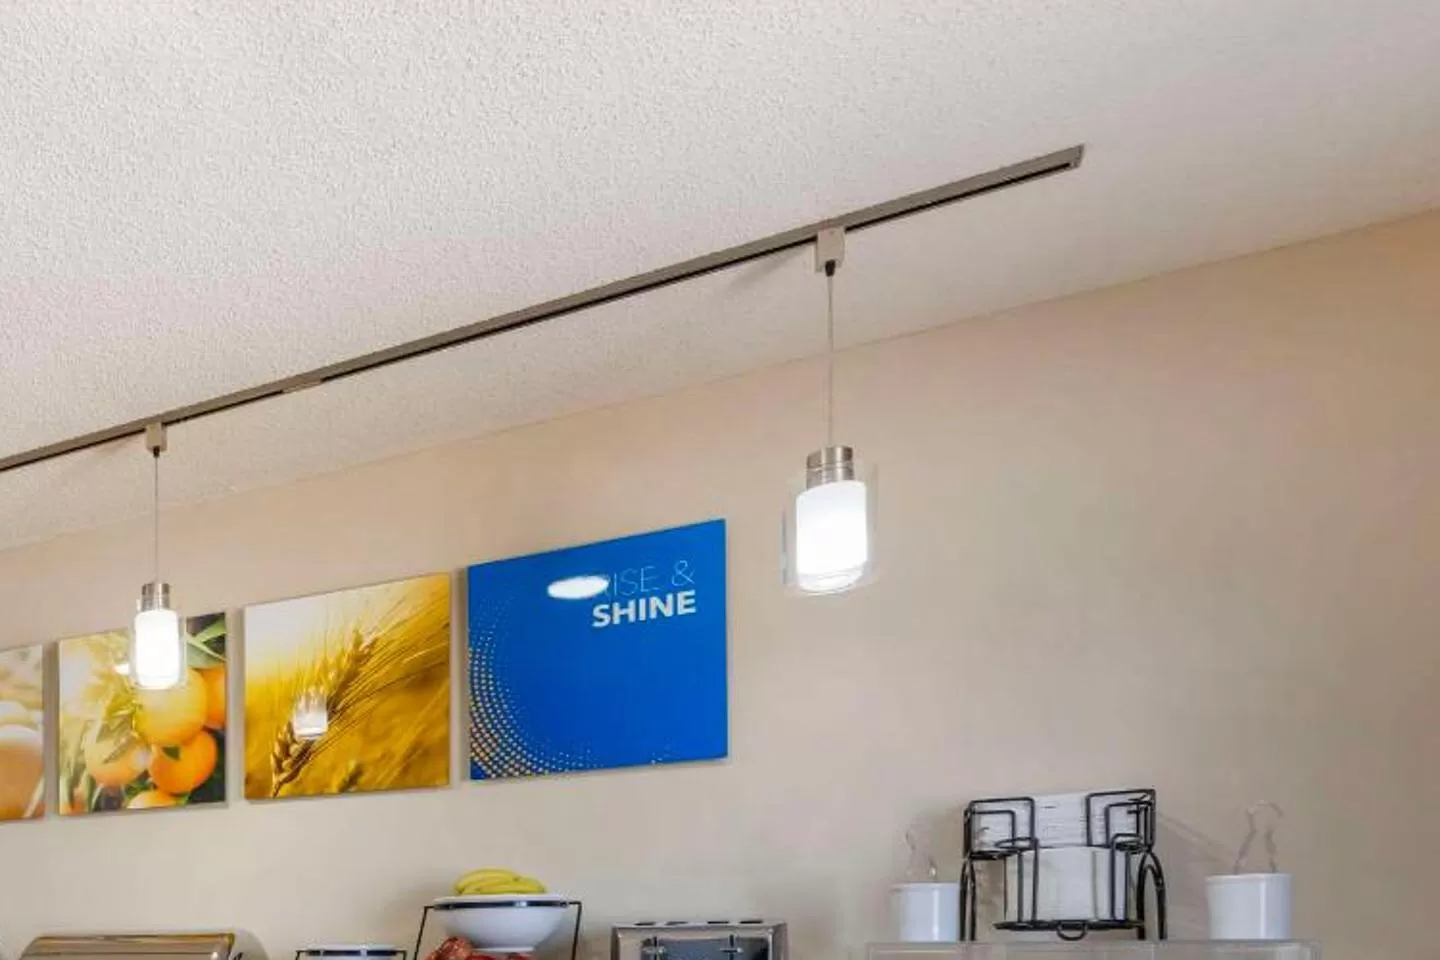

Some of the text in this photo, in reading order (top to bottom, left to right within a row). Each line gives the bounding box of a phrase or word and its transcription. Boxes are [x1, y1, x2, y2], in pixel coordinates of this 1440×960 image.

[599, 559, 695, 598] ISE &
[592, 589, 696, 628] SHINE
